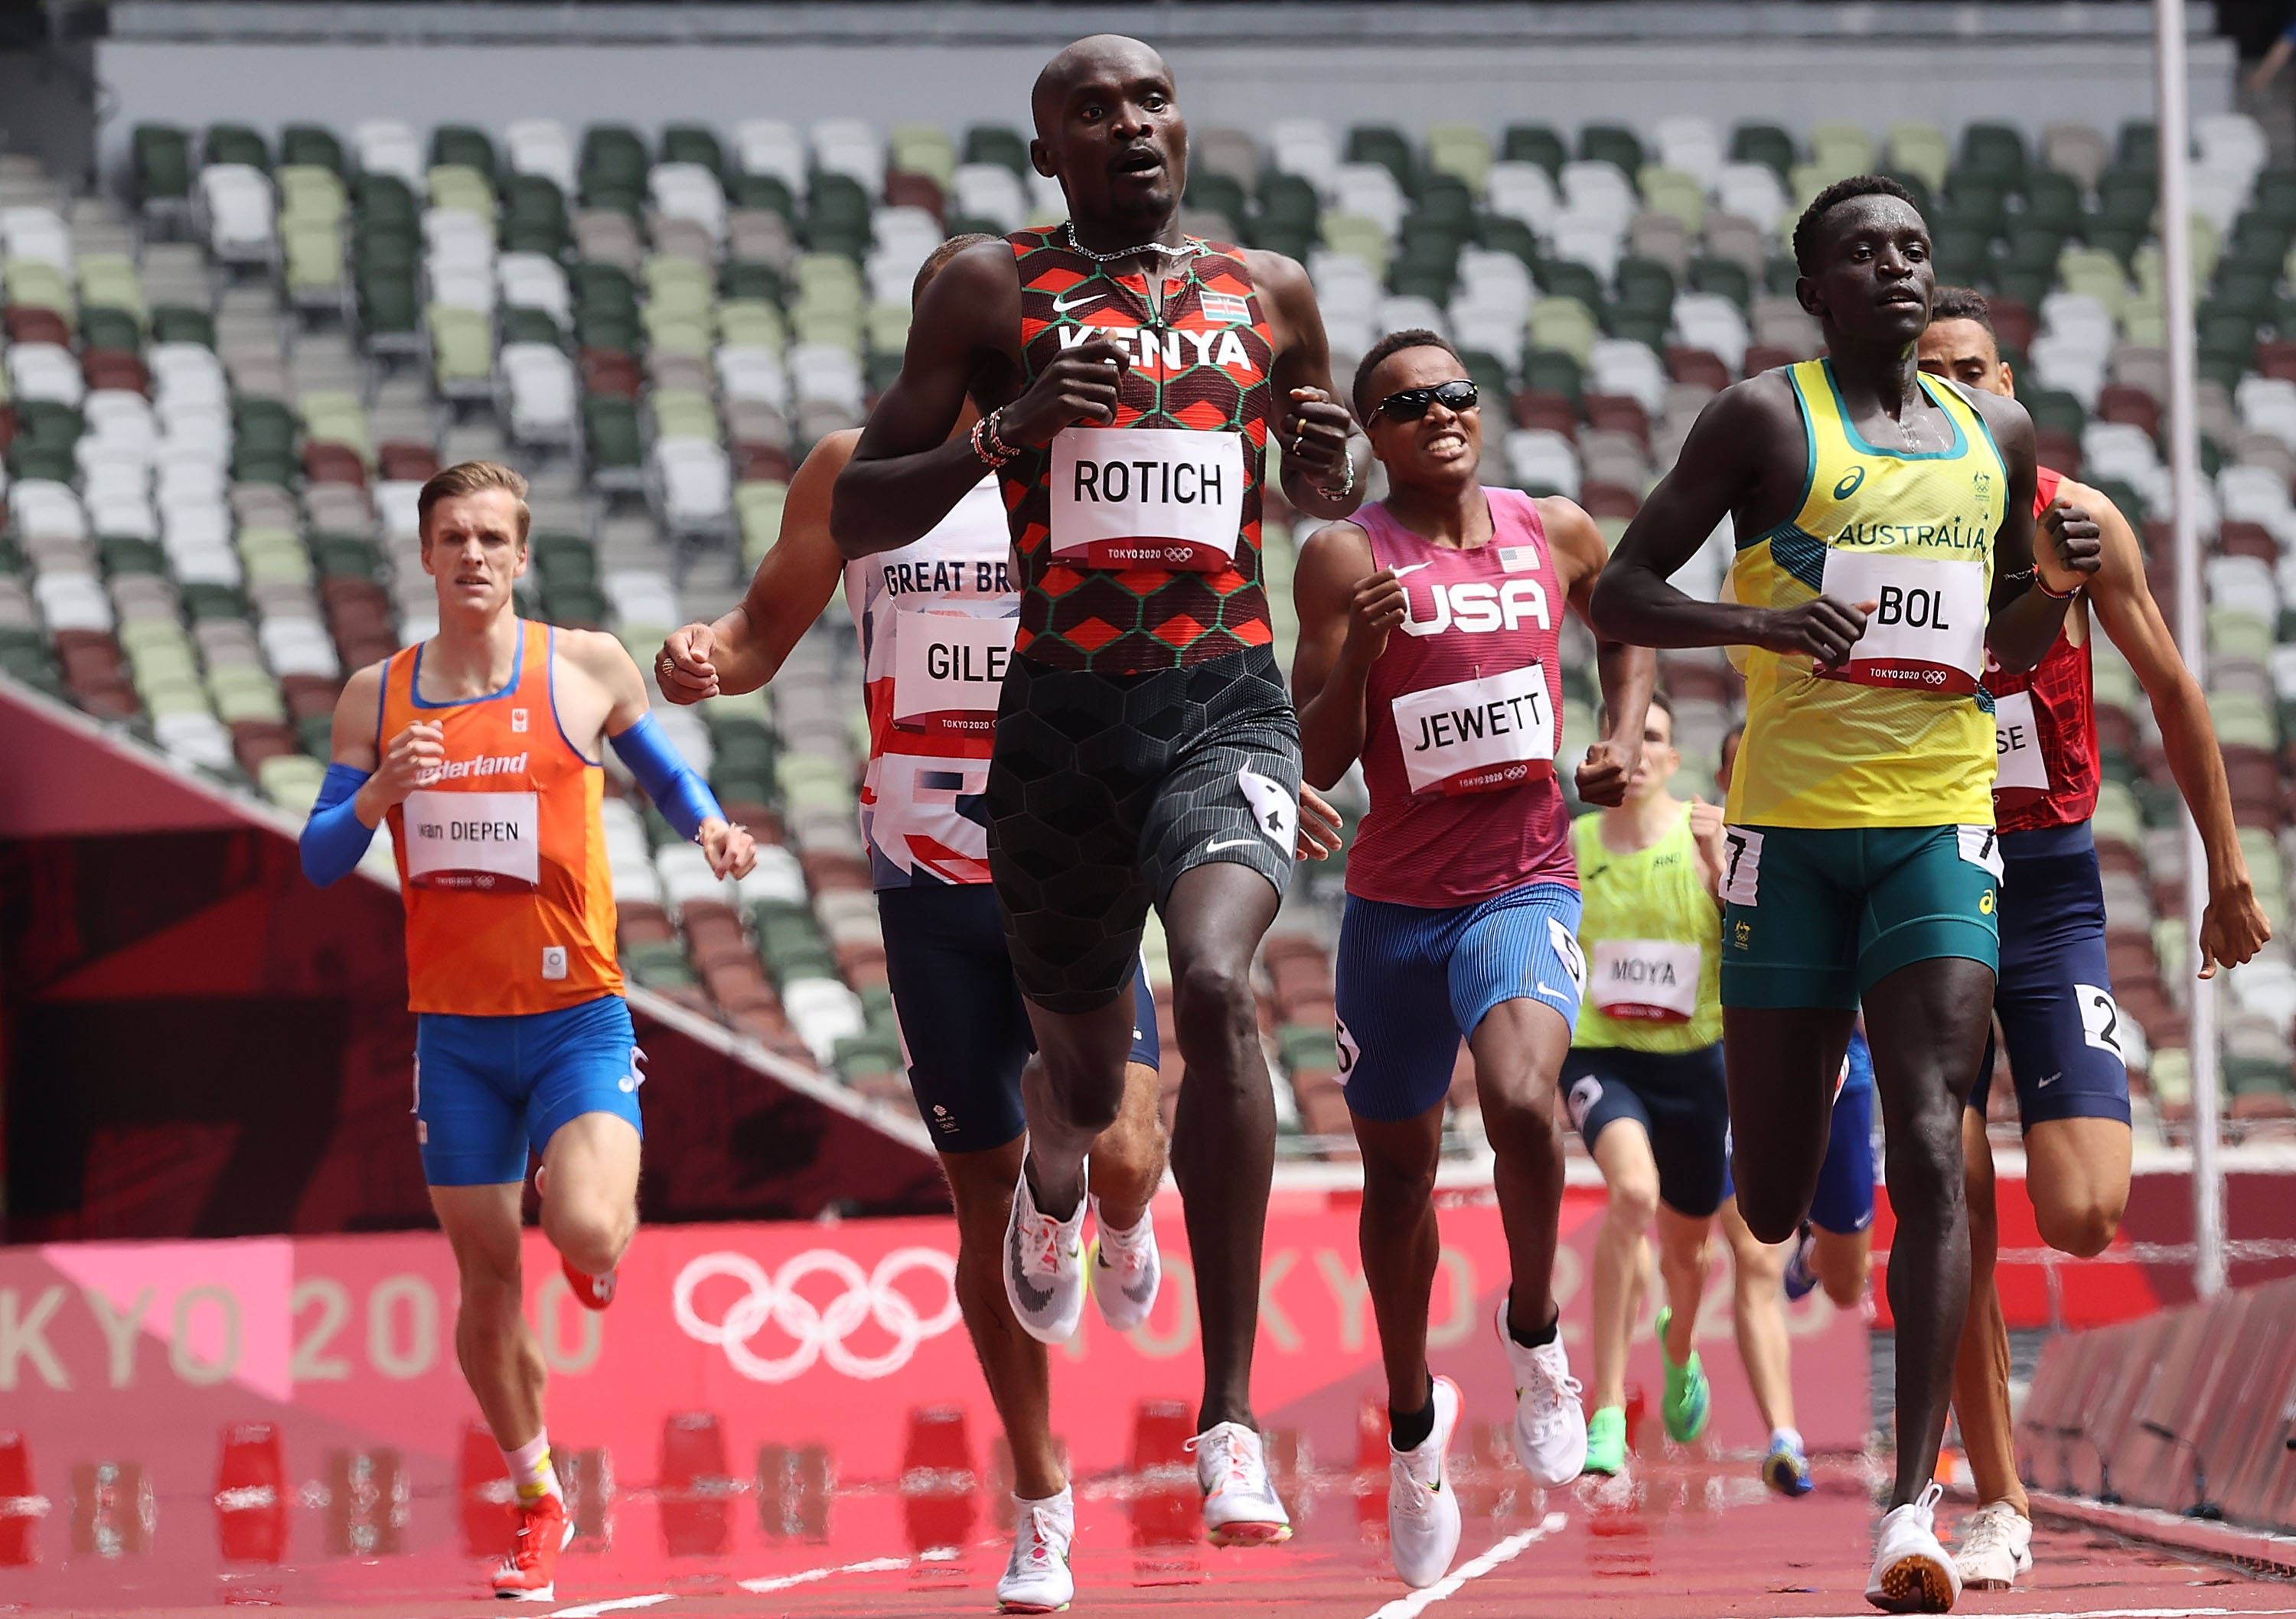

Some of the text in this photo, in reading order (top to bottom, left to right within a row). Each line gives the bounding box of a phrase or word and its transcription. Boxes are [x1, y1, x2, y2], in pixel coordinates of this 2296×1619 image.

[1075, 460, 1222, 505] ROTICH
[1836, 523, 1985, 549] AUSTRALIA
[1108, 549, 1161, 559] TOKYO 2020
[883, 562, 966, 597] GREAT
[1400, 578, 1551, 637] USA
[1877, 585, 1949, 630] BOL
[1870, 668, 1919, 680] TOKYO 2020
[942, 719, 990, 729] TOKYO 2020
[1414, 692, 1540, 751] JEWETT
[1459, 772, 1503, 788] TOKYO 2020
[417, 821, 519, 842] van DIEPEN
[1612, 959, 1676, 986] MOYA
[2094, 996, 2121, 1052] 2
[289, 1272, 605, 1379] 200
